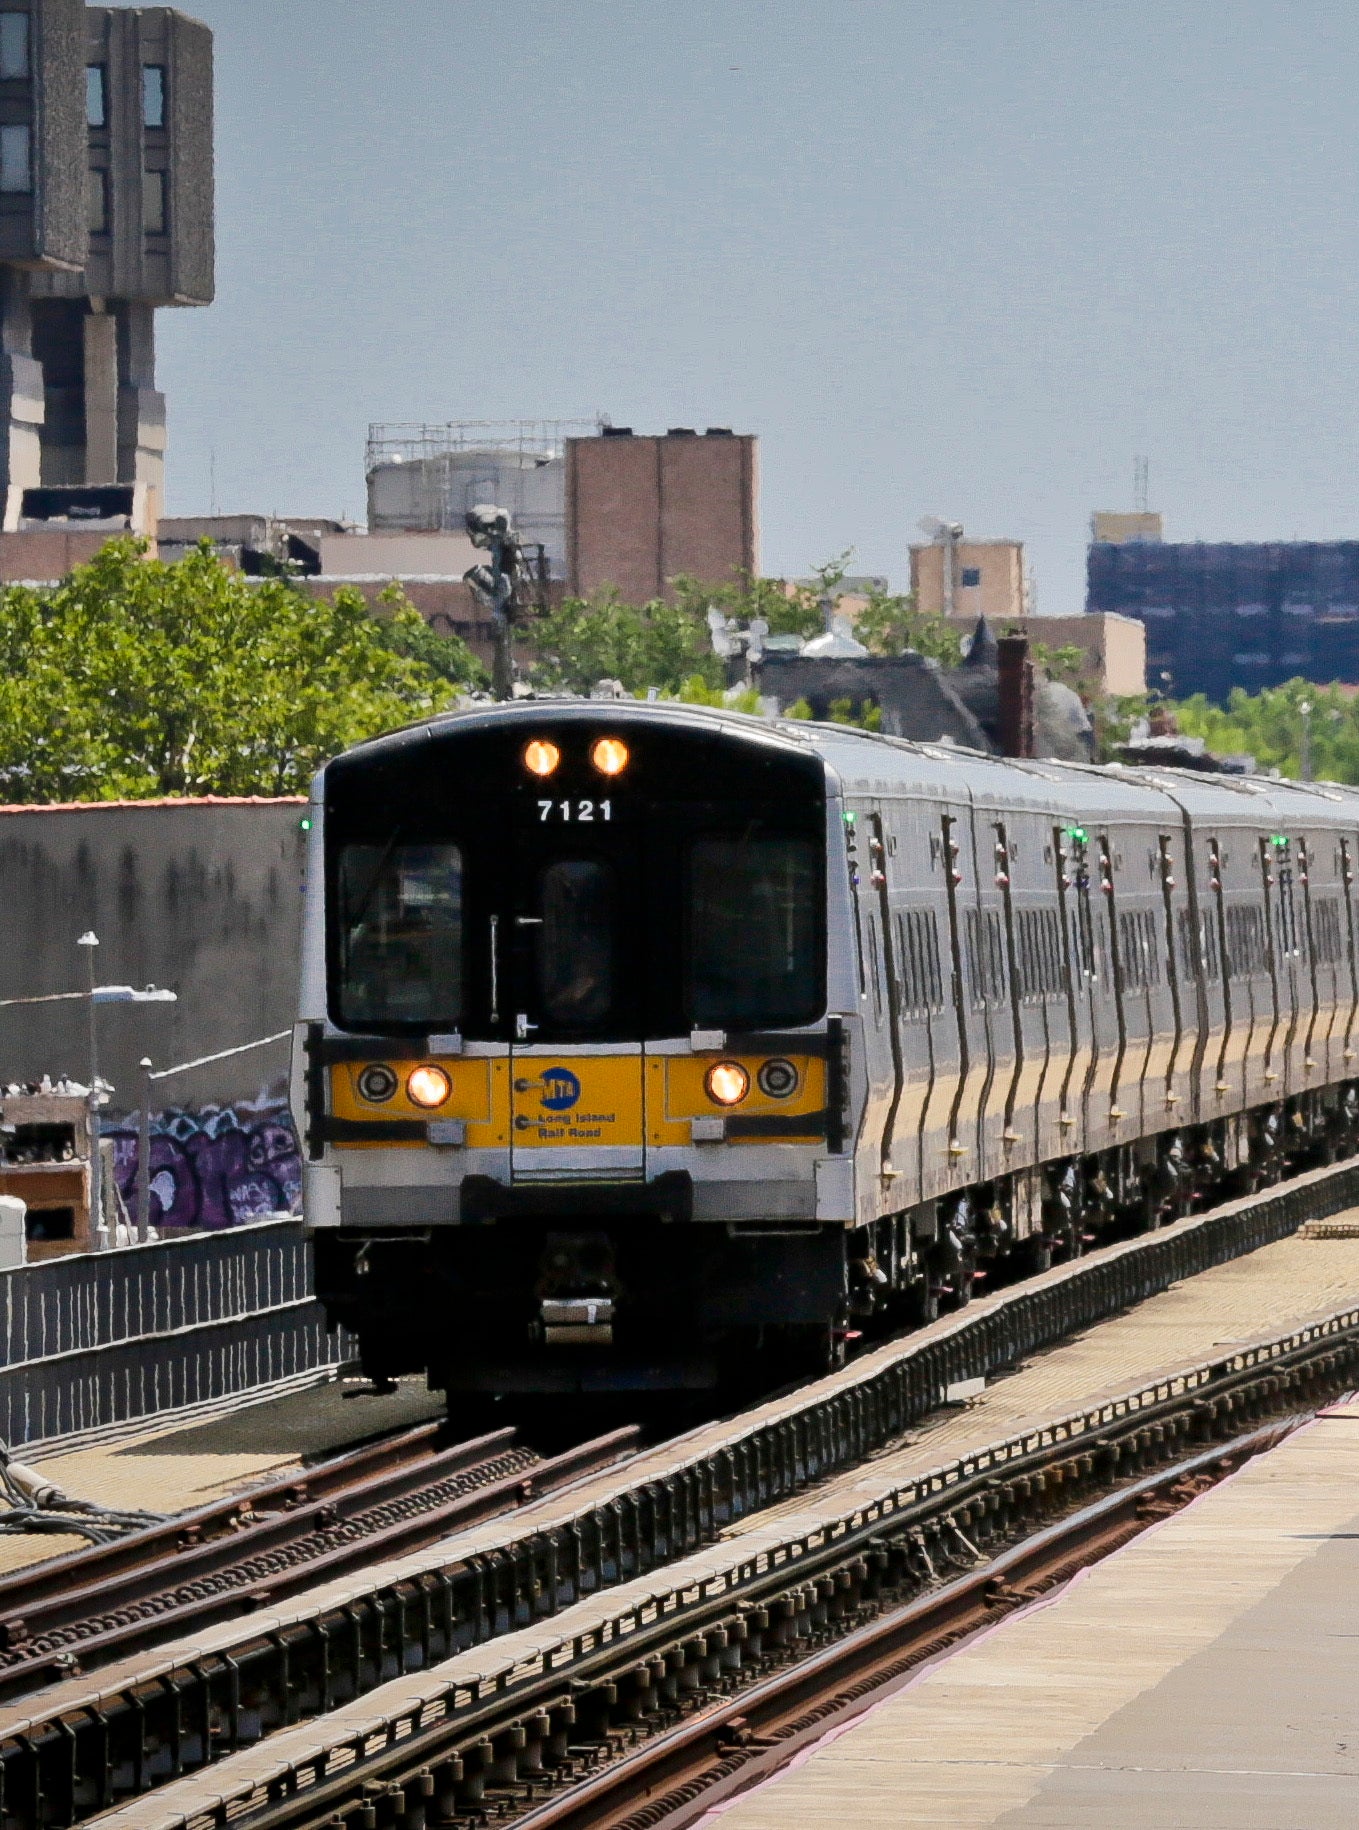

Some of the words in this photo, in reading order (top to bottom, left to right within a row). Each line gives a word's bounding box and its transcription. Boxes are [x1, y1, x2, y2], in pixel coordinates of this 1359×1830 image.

[537, 799, 611, 821] 7121
[538, 1113, 571, 1125] Long
[576, 1113, 615, 1123] Island
[538, 1128, 565, 1138] Rail
[567, 1127, 602, 1138] Road
